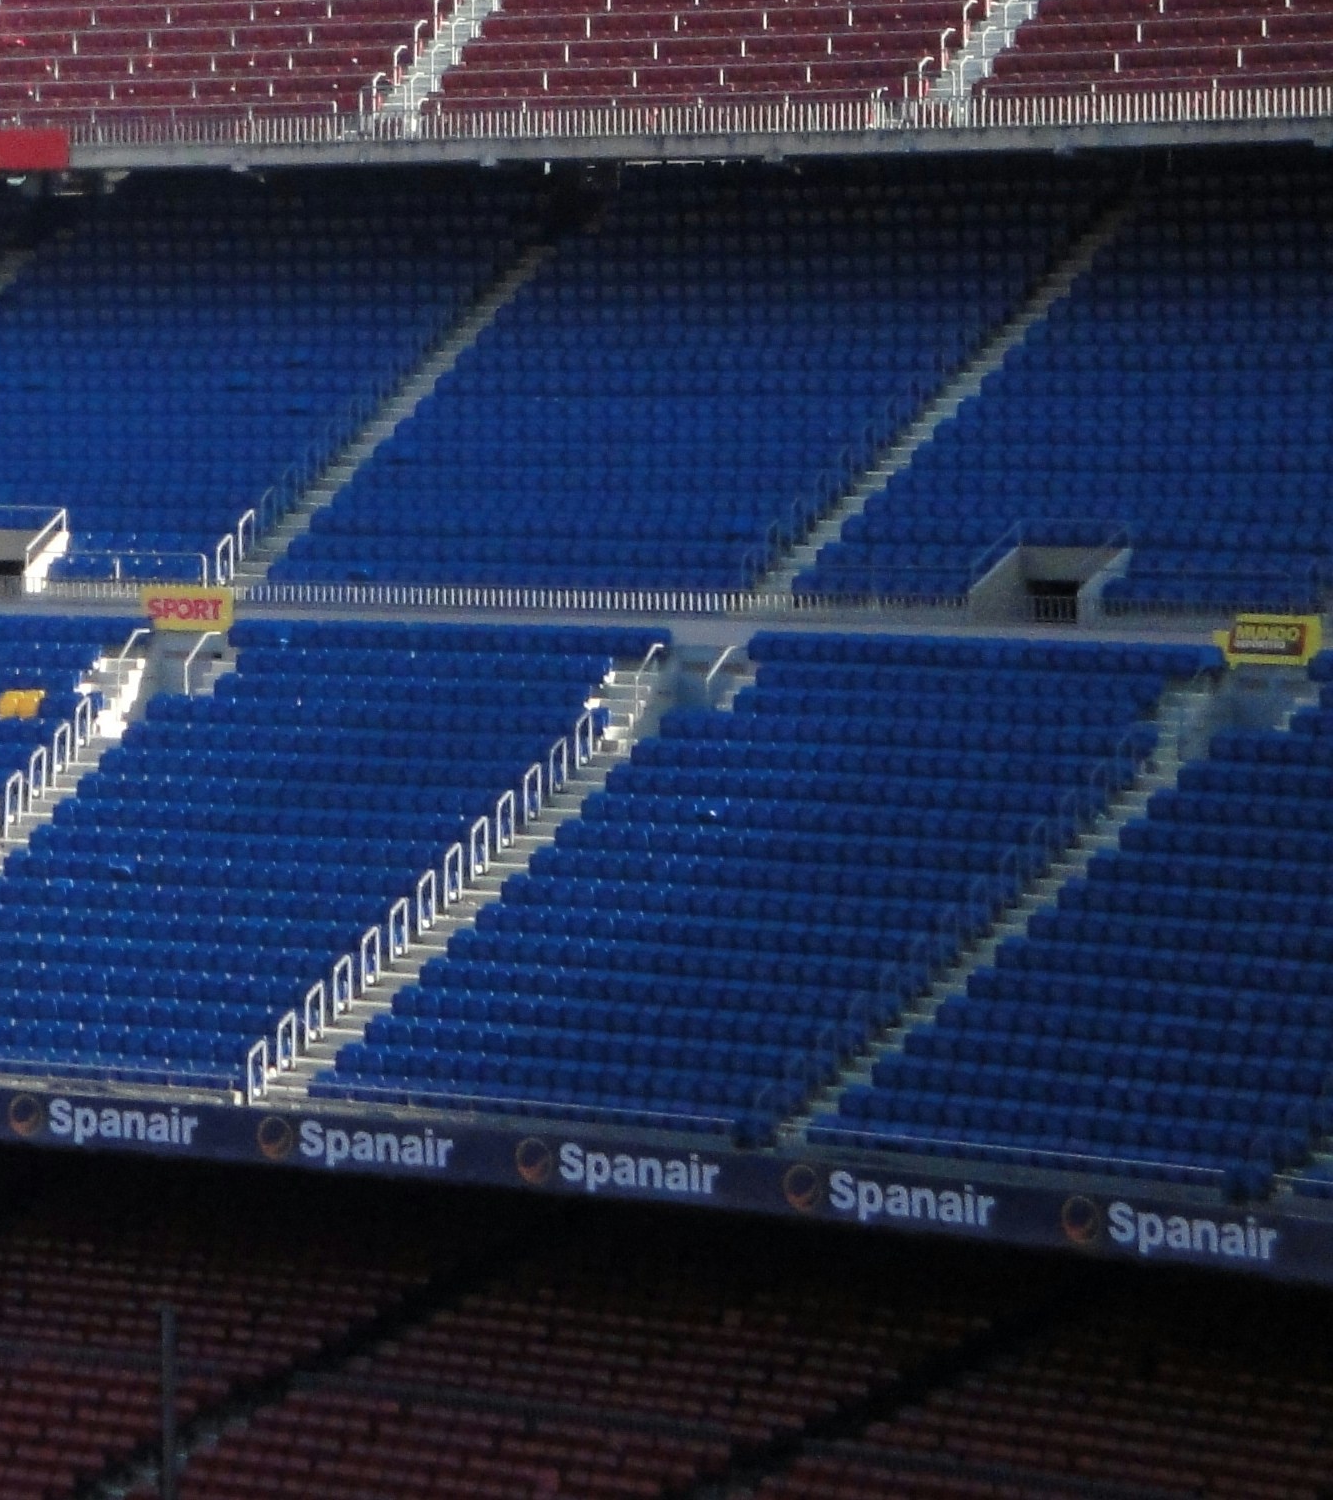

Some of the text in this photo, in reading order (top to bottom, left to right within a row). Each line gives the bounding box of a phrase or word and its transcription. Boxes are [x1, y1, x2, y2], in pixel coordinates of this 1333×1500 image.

[147, 598, 223, 621] SPORT
[1235, 623, 1301, 642] MUNDO
[48, 1099, 199, 1145] Spanair
[299, 1120, 453, 1167] Spanair
[558, 1142, 720, 1194] Spanair
[829, 1170, 995, 1227] Spanair
[1108, 1202, 1278, 1262] Spanair
